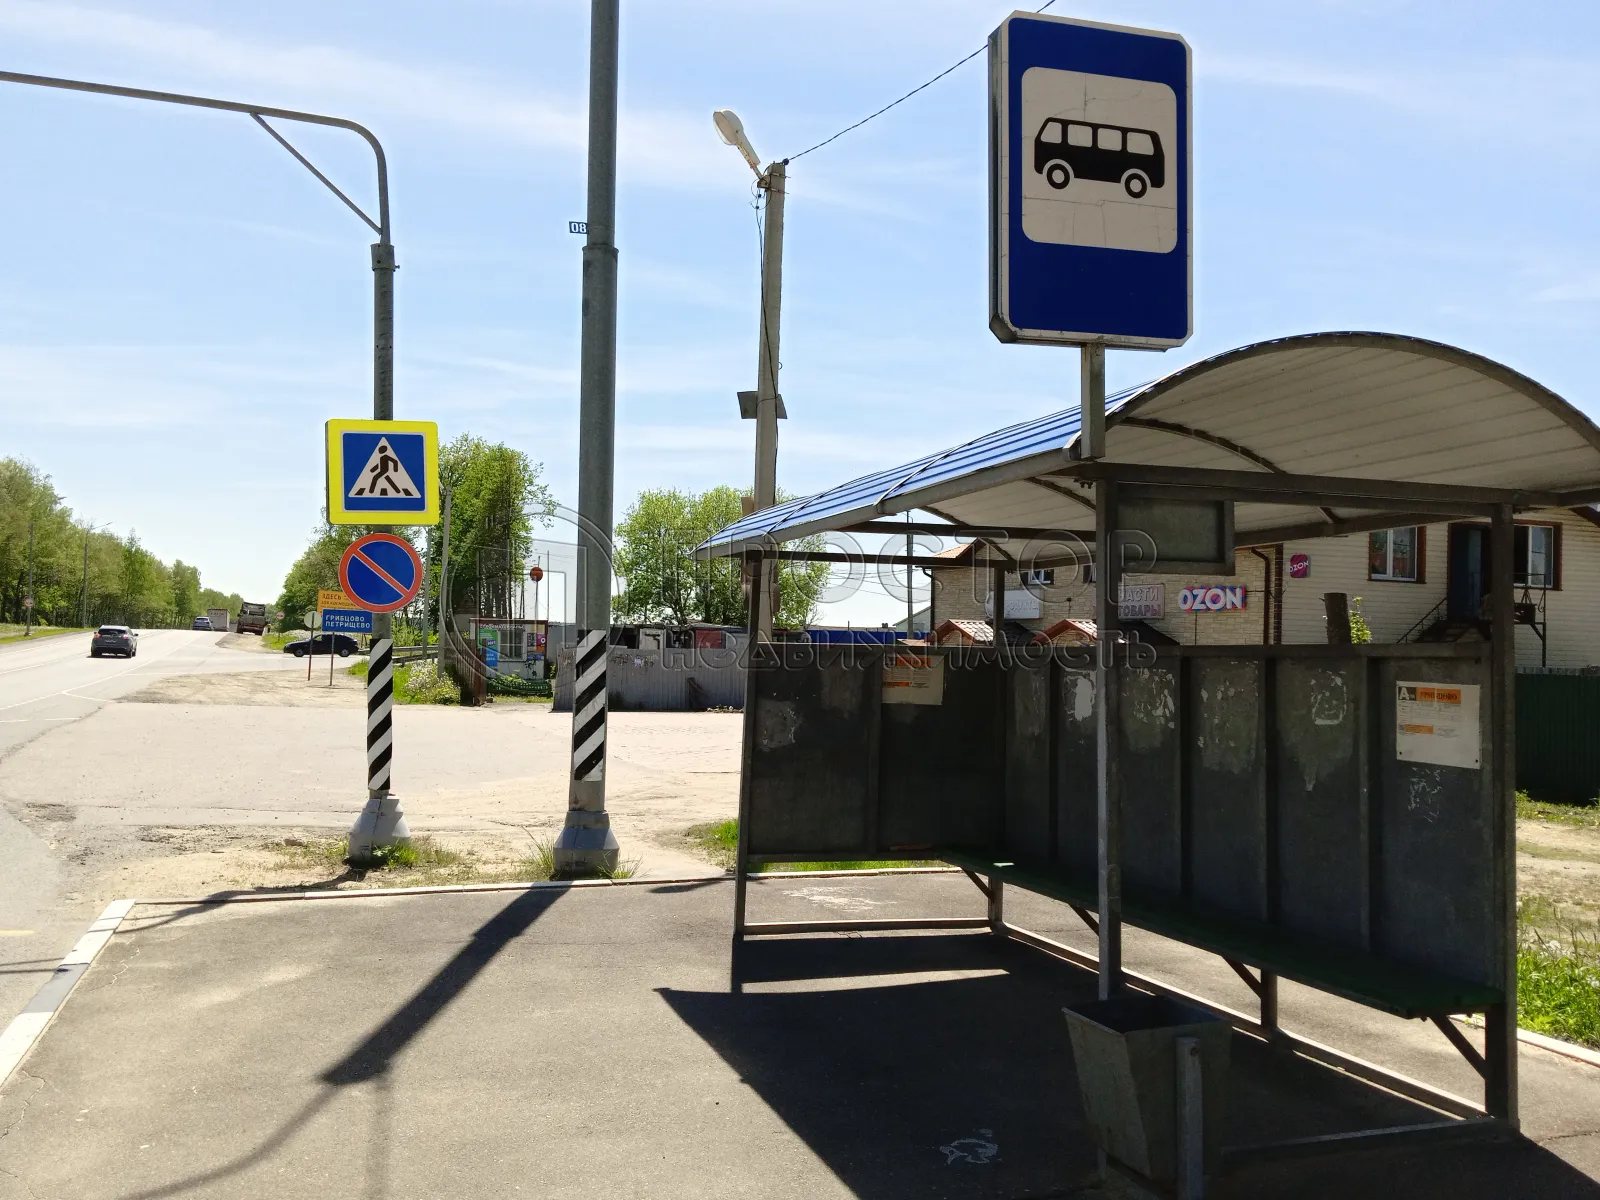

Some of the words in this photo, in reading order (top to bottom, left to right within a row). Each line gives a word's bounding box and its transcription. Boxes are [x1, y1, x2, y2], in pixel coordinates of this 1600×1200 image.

[571, 222, 587, 233] 08
[1289, 559, 1309, 574] OZON
[1177, 586, 1245, 611] OZON
[325, 614, 365, 622] ГРИБЦОВО
[325, 621, 371, 629] ПЕТРИЩЕВО
